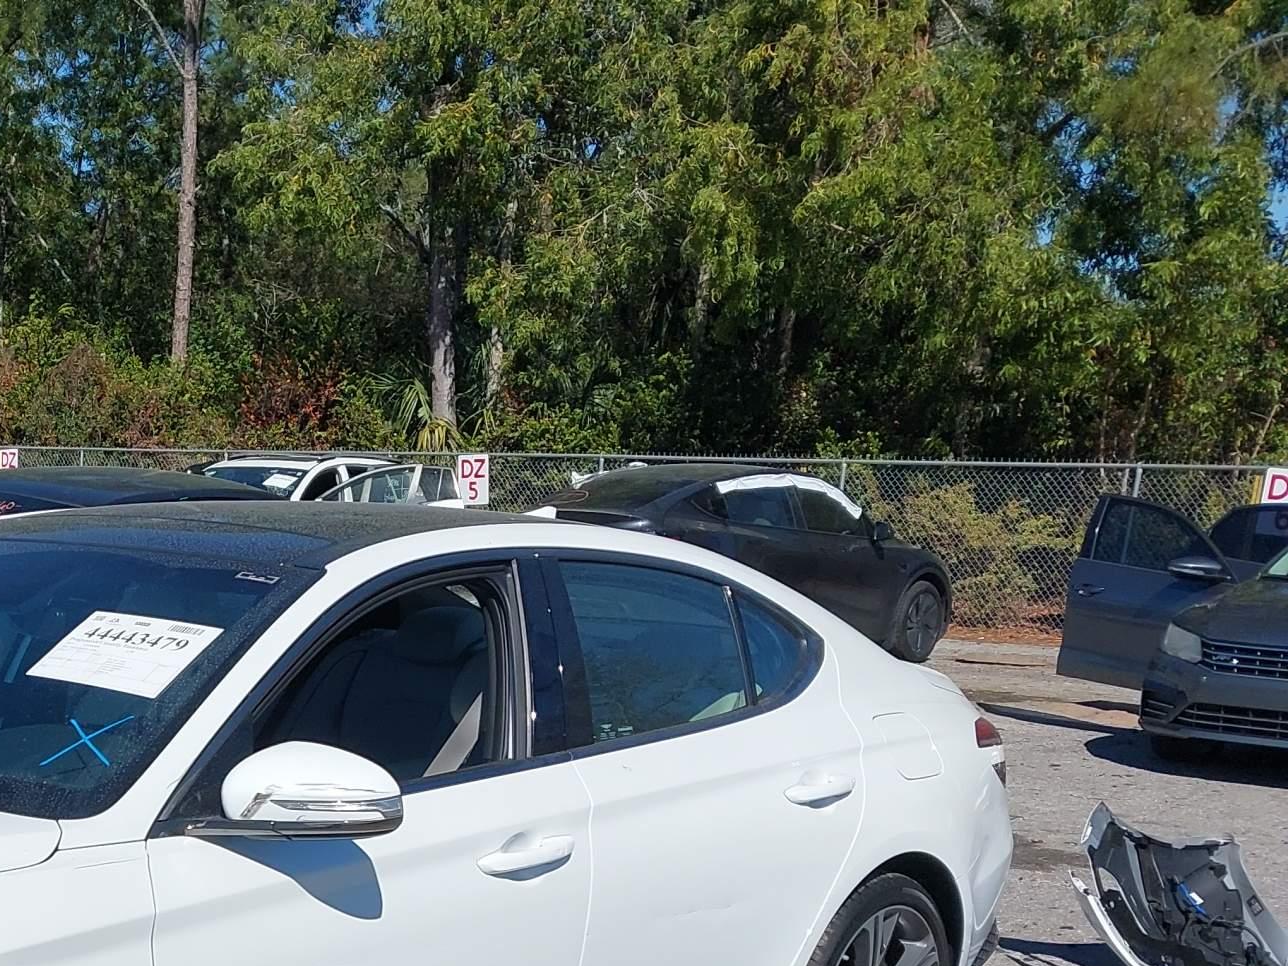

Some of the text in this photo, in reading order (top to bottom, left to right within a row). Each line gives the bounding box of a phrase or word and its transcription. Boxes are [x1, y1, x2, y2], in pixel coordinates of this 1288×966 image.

[2, 452, 16, 468] DZ
[461, 459, 485, 478] DZ
[469, 481, 478, 500] 5
[84, 627, 189, 651] 44443479
